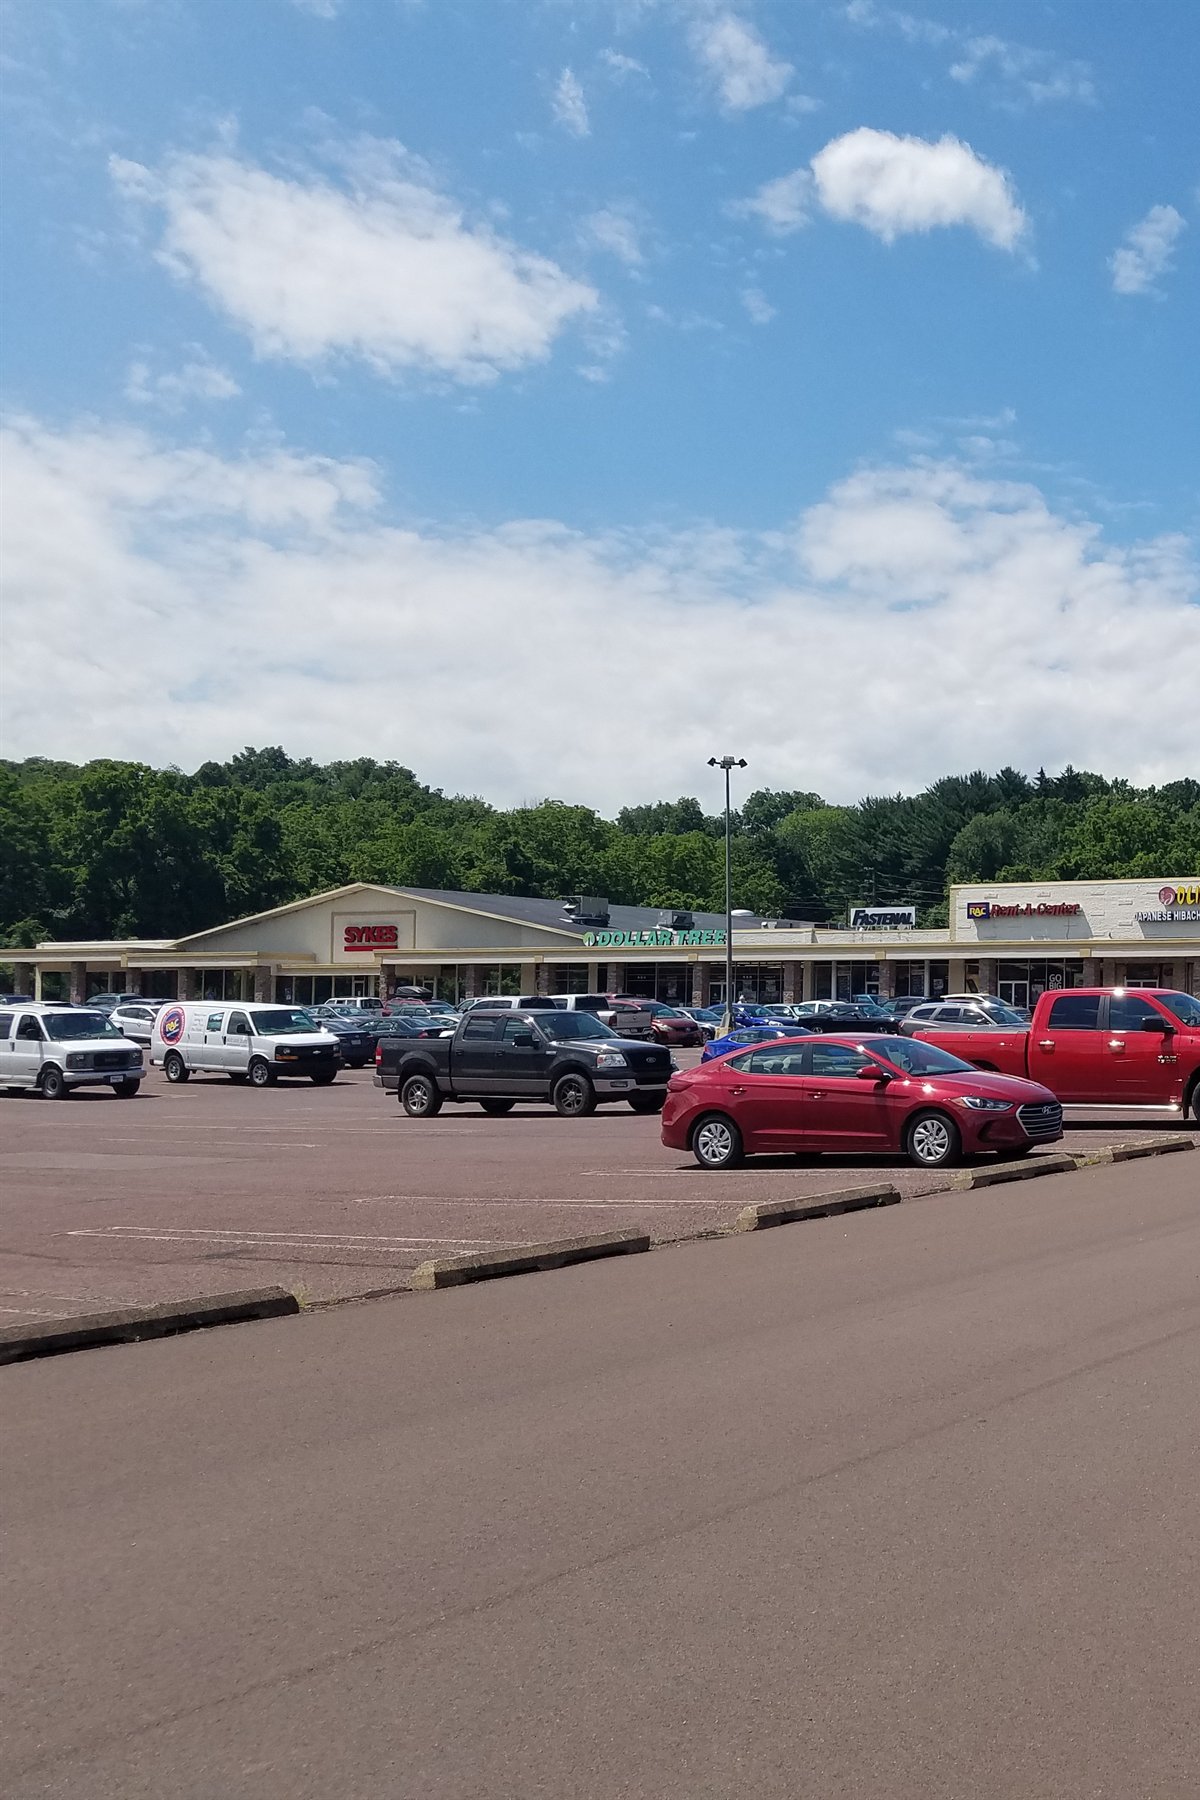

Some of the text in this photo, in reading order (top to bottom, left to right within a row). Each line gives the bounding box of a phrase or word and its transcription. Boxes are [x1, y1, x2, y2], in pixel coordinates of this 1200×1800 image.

[969, 907, 986, 917] RAC
[1135, 911, 1171, 921] JAPANESE
[852, 909, 914, 926] FASTENAL
[344, 925, 398, 943] SYKES
[598, 929, 727, 946] DOLLAR TREE
[1049, 974, 1062, 982] GO
[1049, 982, 1062, 990] BIG
